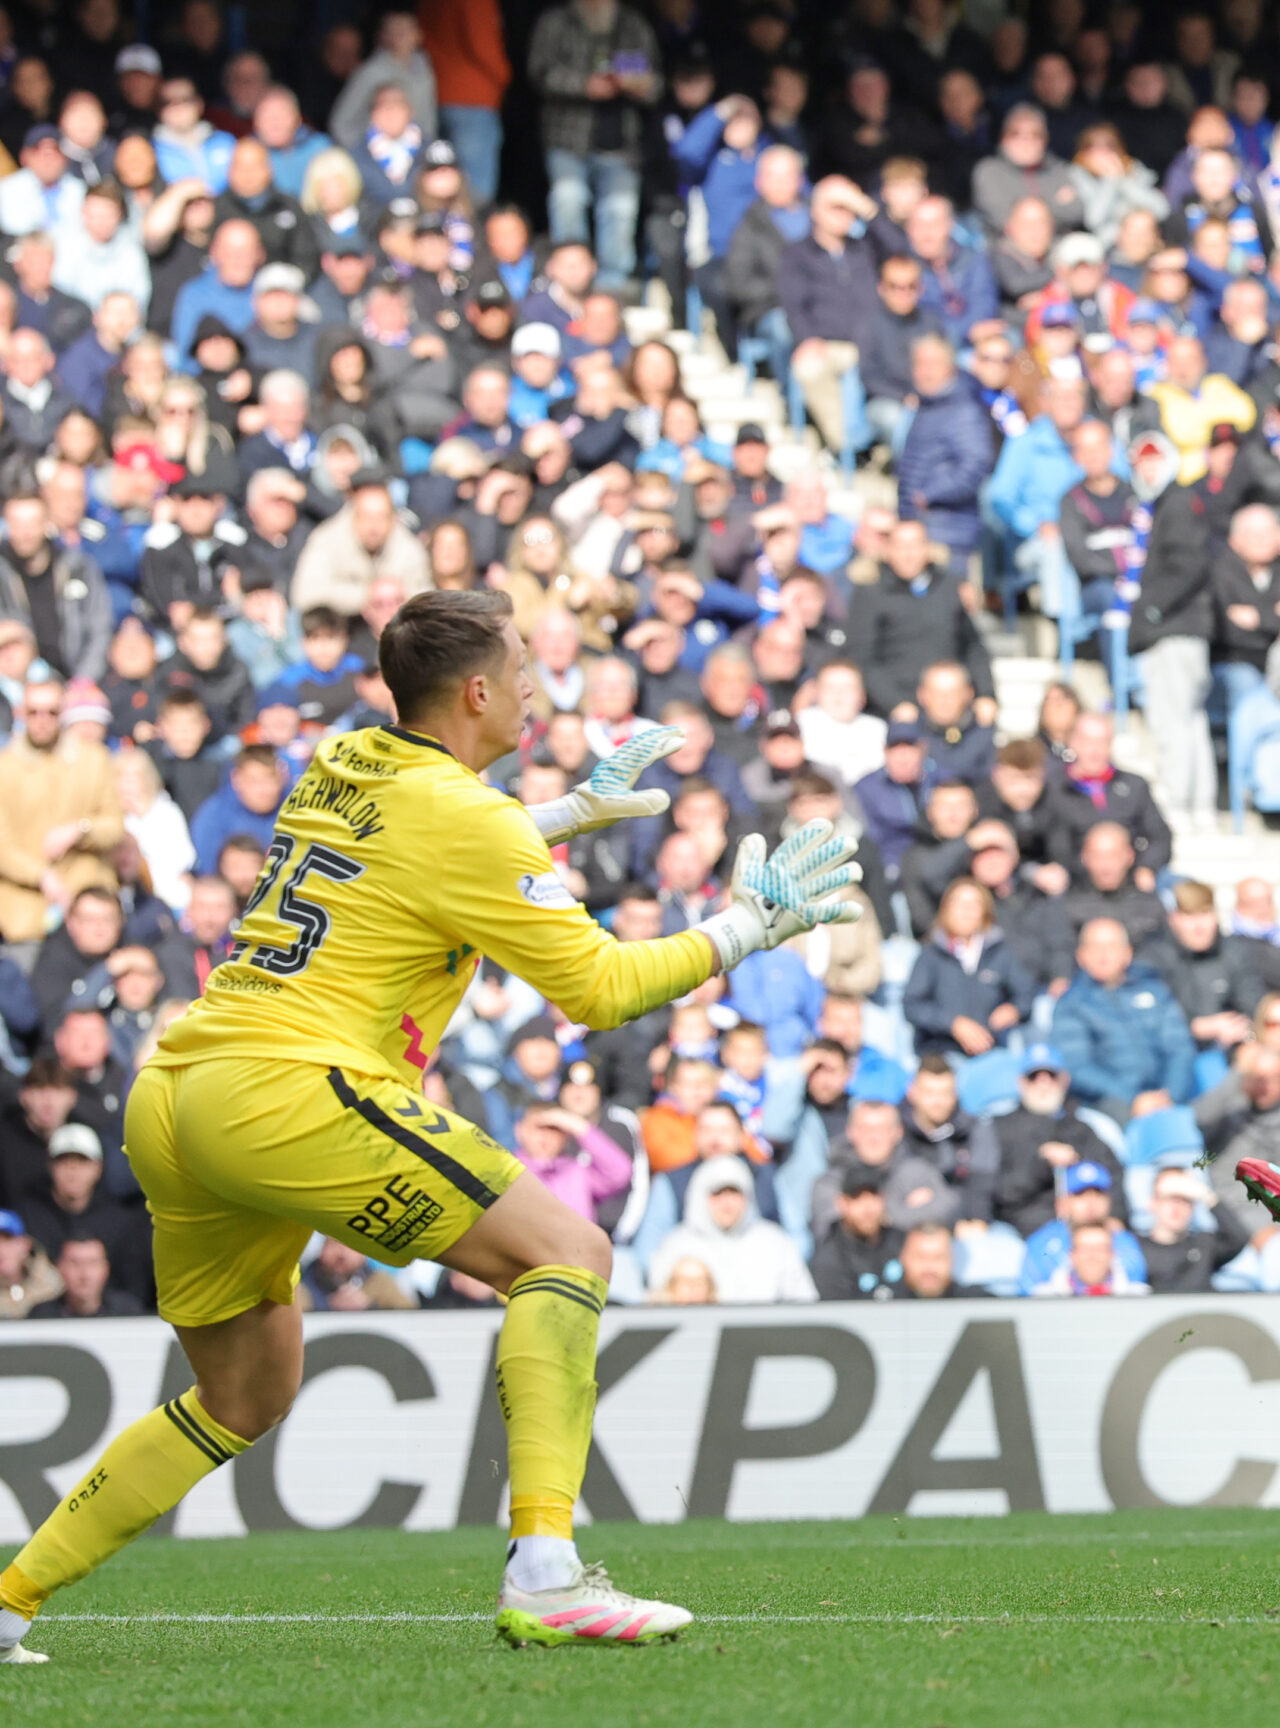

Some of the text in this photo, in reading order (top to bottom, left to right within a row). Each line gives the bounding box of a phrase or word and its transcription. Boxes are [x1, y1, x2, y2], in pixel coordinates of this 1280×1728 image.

[345, 752, 399, 777] FanH
[346, 1174, 423, 1239] PPE
[421, 1203, 443, 1229] LTD
[68, 1467, 108, 1512] HMFC
